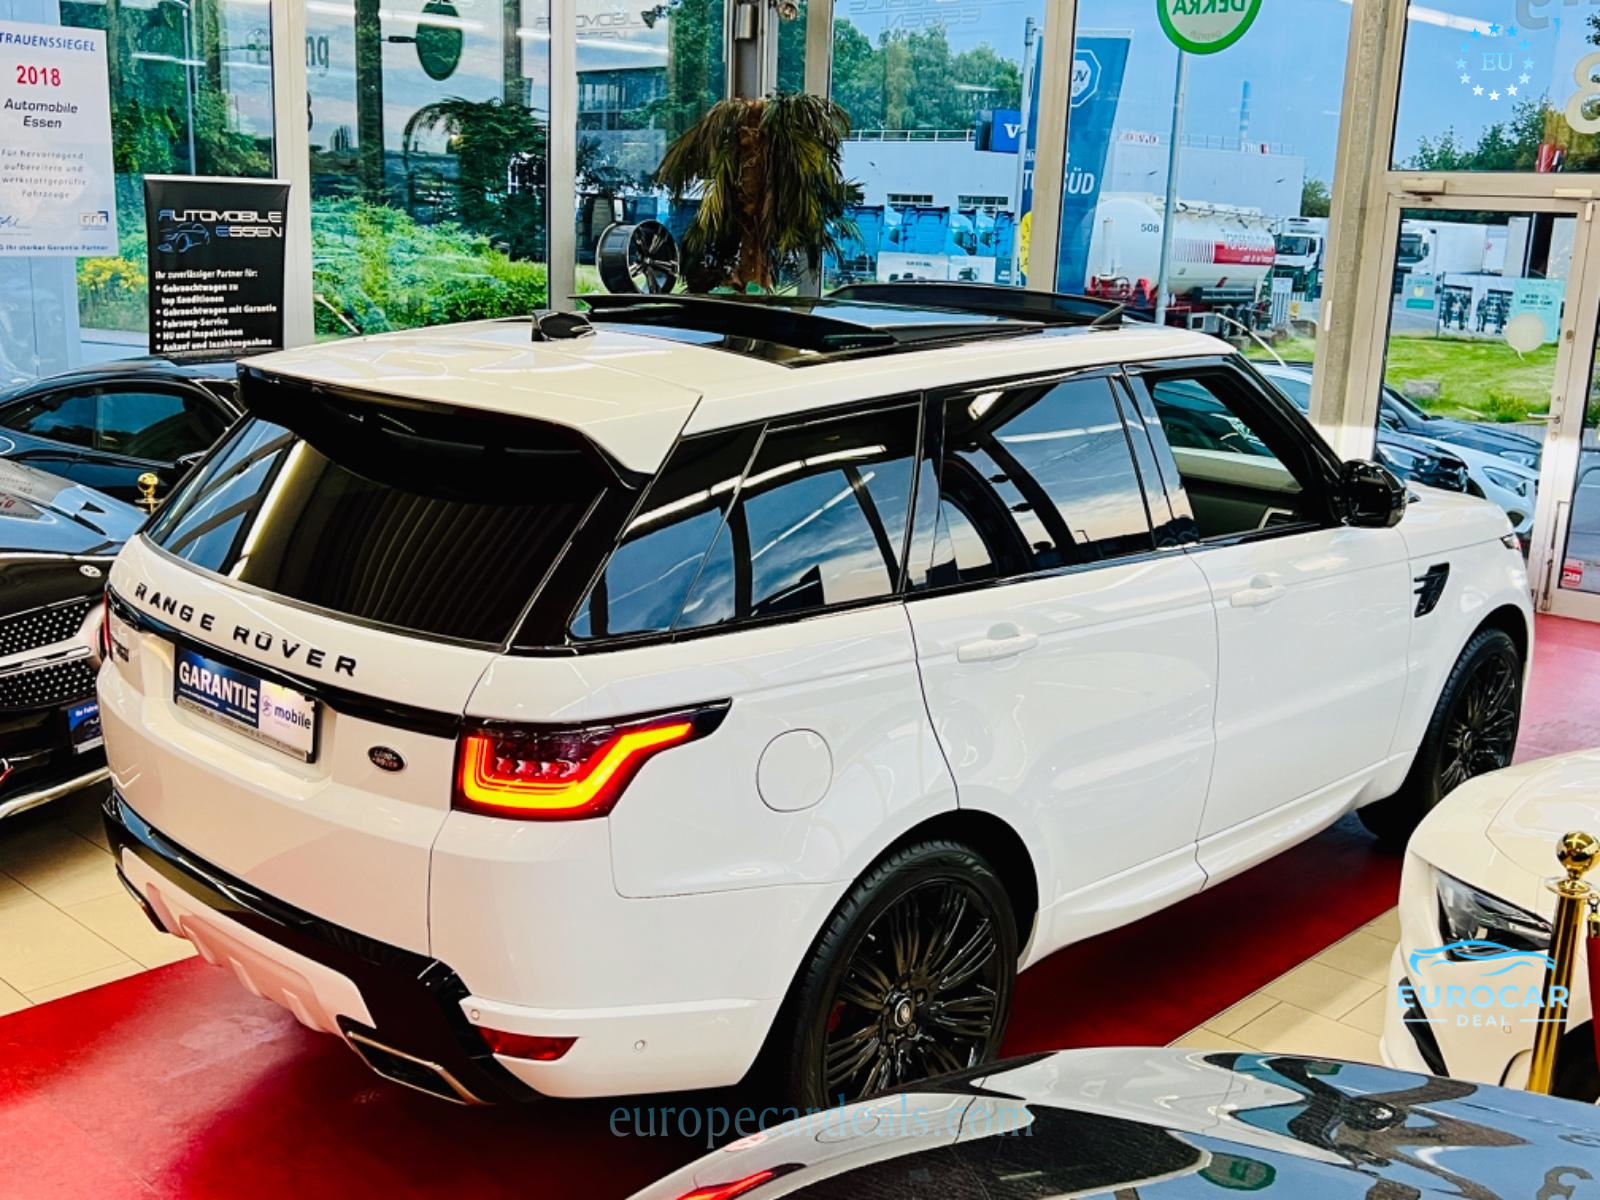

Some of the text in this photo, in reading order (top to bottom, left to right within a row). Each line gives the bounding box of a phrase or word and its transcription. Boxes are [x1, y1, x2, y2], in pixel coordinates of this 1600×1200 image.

[16, 65, 61, 86] 2018
[4, 98, 78, 114] Automobile
[23, 116, 62, 129] Essen
[158, 209, 282, 223] AUTOMOBILE
[215, 226, 282, 237] ESSEN
[1140, 223, 1160, 233] 508
[155, 271, 166, 279] Ihr
[216, 269, 244, 278] Partner
[162, 284, 227, 293] Gebrauchtwagen
[162, 304, 277, 316] Gebrauchtwagen mit Garantie
[175, 330, 191, 339] und
[191, 341, 207, 350] und
[135, 582, 357, 677] RANGE ROVER
[179, 661, 258, 714] GARANTIE
[273, 705, 312, 730] mobile
